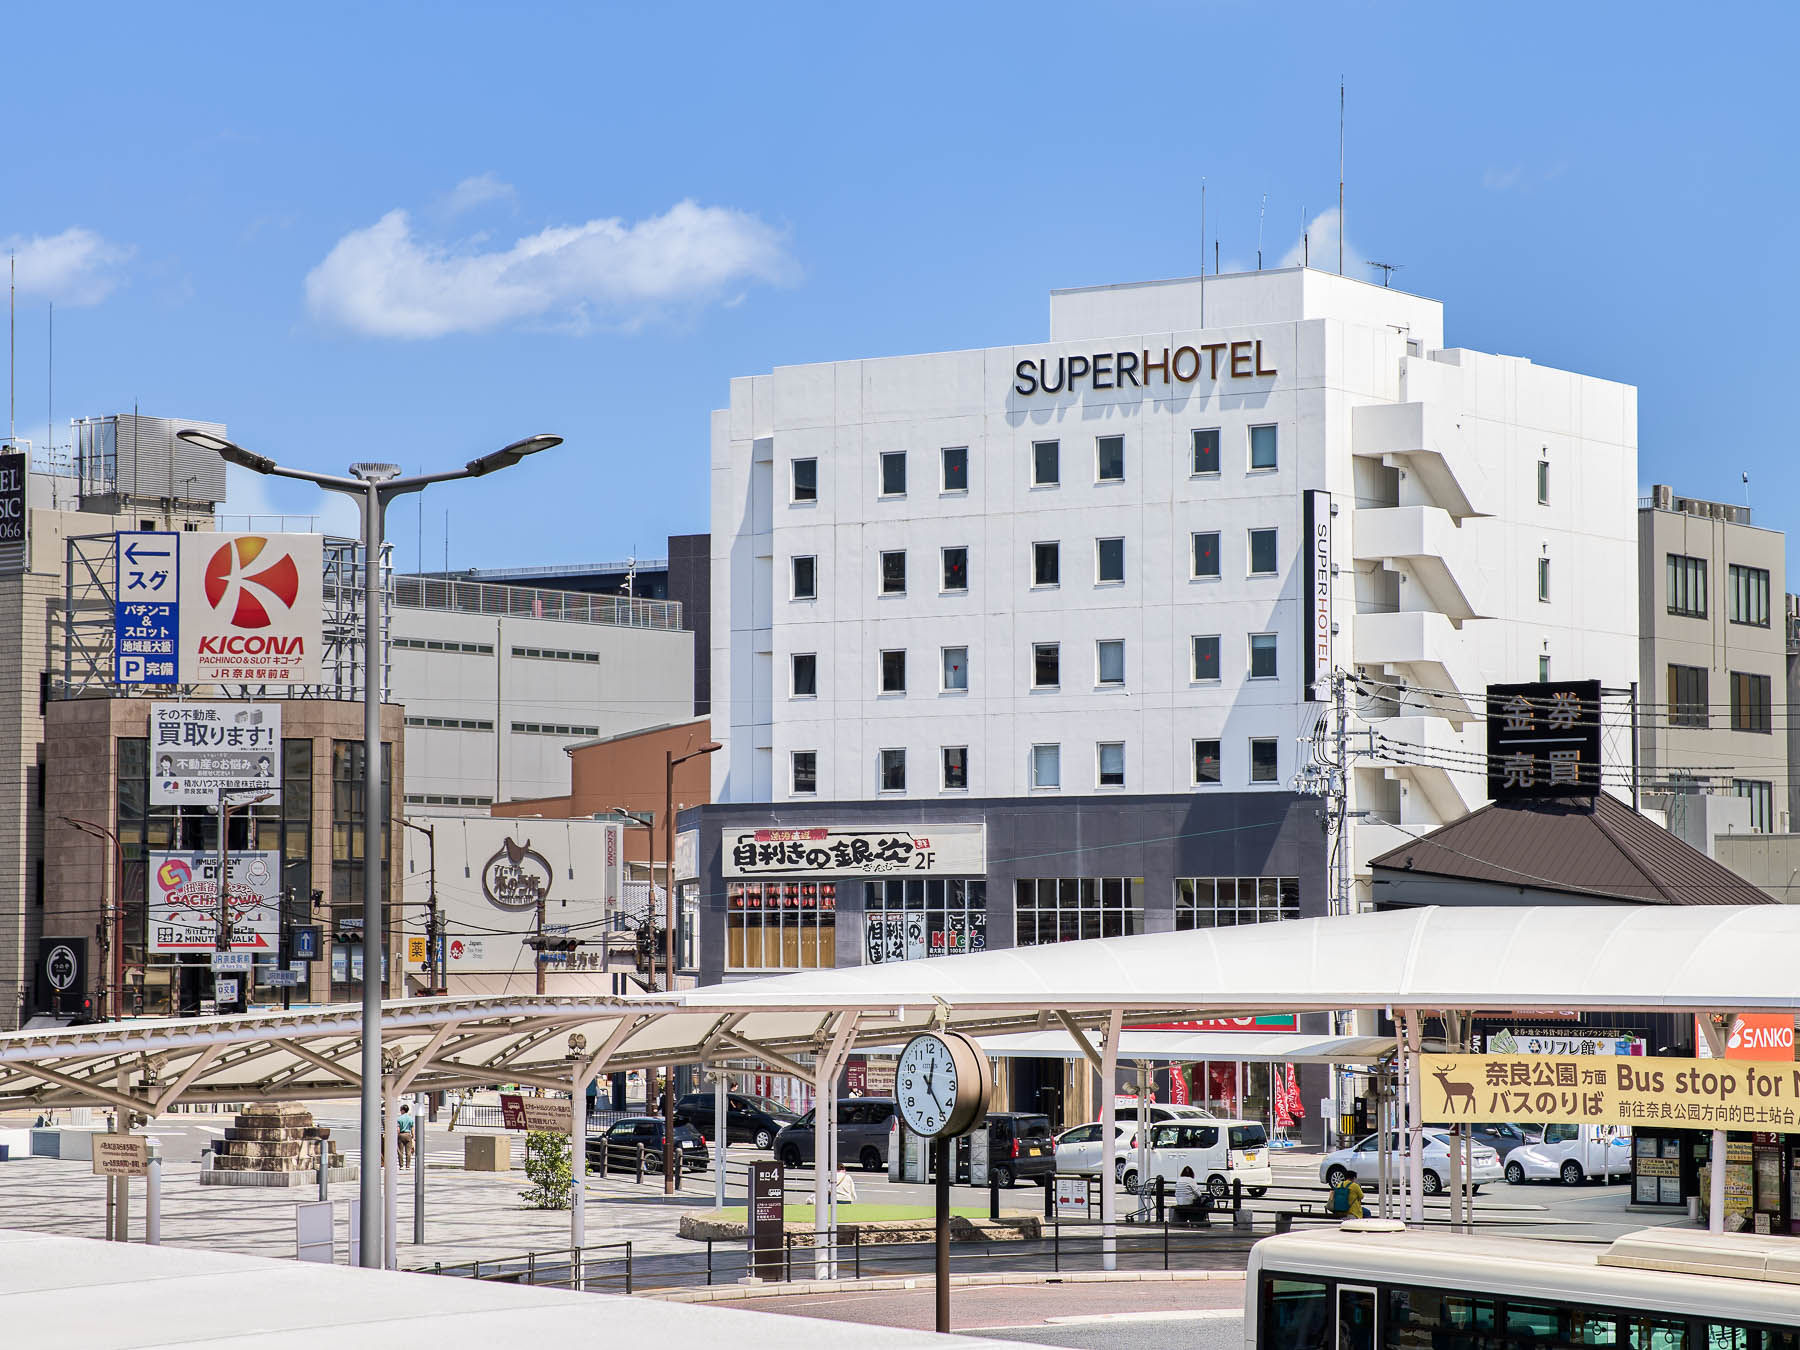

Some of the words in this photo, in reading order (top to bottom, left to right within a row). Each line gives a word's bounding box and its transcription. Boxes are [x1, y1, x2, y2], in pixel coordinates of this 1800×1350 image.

[1015, 340, 1278, 396] SUPERHOTEL
[127, 570, 169, 591] スグ
[1317, 524, 1329, 669] SUPERHOTEL
[125, 605, 170, 616] パチンコ
[142, 616, 152, 627] &
[125, 627, 169, 637] スロット
[122, 640, 172, 653] 地域最大級
[198, 636, 305, 655] KICONA
[146, 662, 174, 676] 完備
[211, 668, 290, 679] JR奈良駅前店
[157, 709, 221, 721] その不動産、
[1502, 692, 1581, 731] 金券
[176, 758, 252, 771] 不動産のお悩み
[1503, 750, 1581, 789] 売買
[733, 838, 914, 870] 目利きの銀次
[914, 852, 936, 870] 2F
[175, 934, 183, 943] 2
[411, 941, 424, 958] 薬
[213, 954, 250, 964] JR奈良駅前
[1743, 1027, 1793, 1048] SANKO
[926, 1043, 935, 1054] 12
[1543, 1040, 1595, 1055] リフレ館
[915, 1049, 923, 1061] 11
[907, 1064, 916, 1074] 10
[945, 1062, 953, 1073] 2
[1485, 1061, 1578, 1087] 奈良公園
[1581, 1069, 1607, 1085] 方面
[858, 1073, 865, 1087] 1
[905, 1080, 913, 1090] 9
[948, 1080, 956, 1091] 3
[1617, 1064, 1665, 1093] Bus
[1675, 1067, 1737, 1101] stop
[1746, 1067, 1783, 1097] for
[907, 1097, 915, 1107] 8
[945, 1098, 953, 1108] 4
[1489, 1090, 1605, 1116] バスのりば
[516, 1111, 526, 1127] 4
[916, 1112, 923, 1122] 7
[939, 1112, 947, 1122] 5
[1618, 1100, 1794, 1125] 前往奈良公园方向的巴士站台
[926, 1117, 934, 1127] 6
[1770, 1132, 1777, 1143] 2
[771, 1168, 779, 1181] 4
